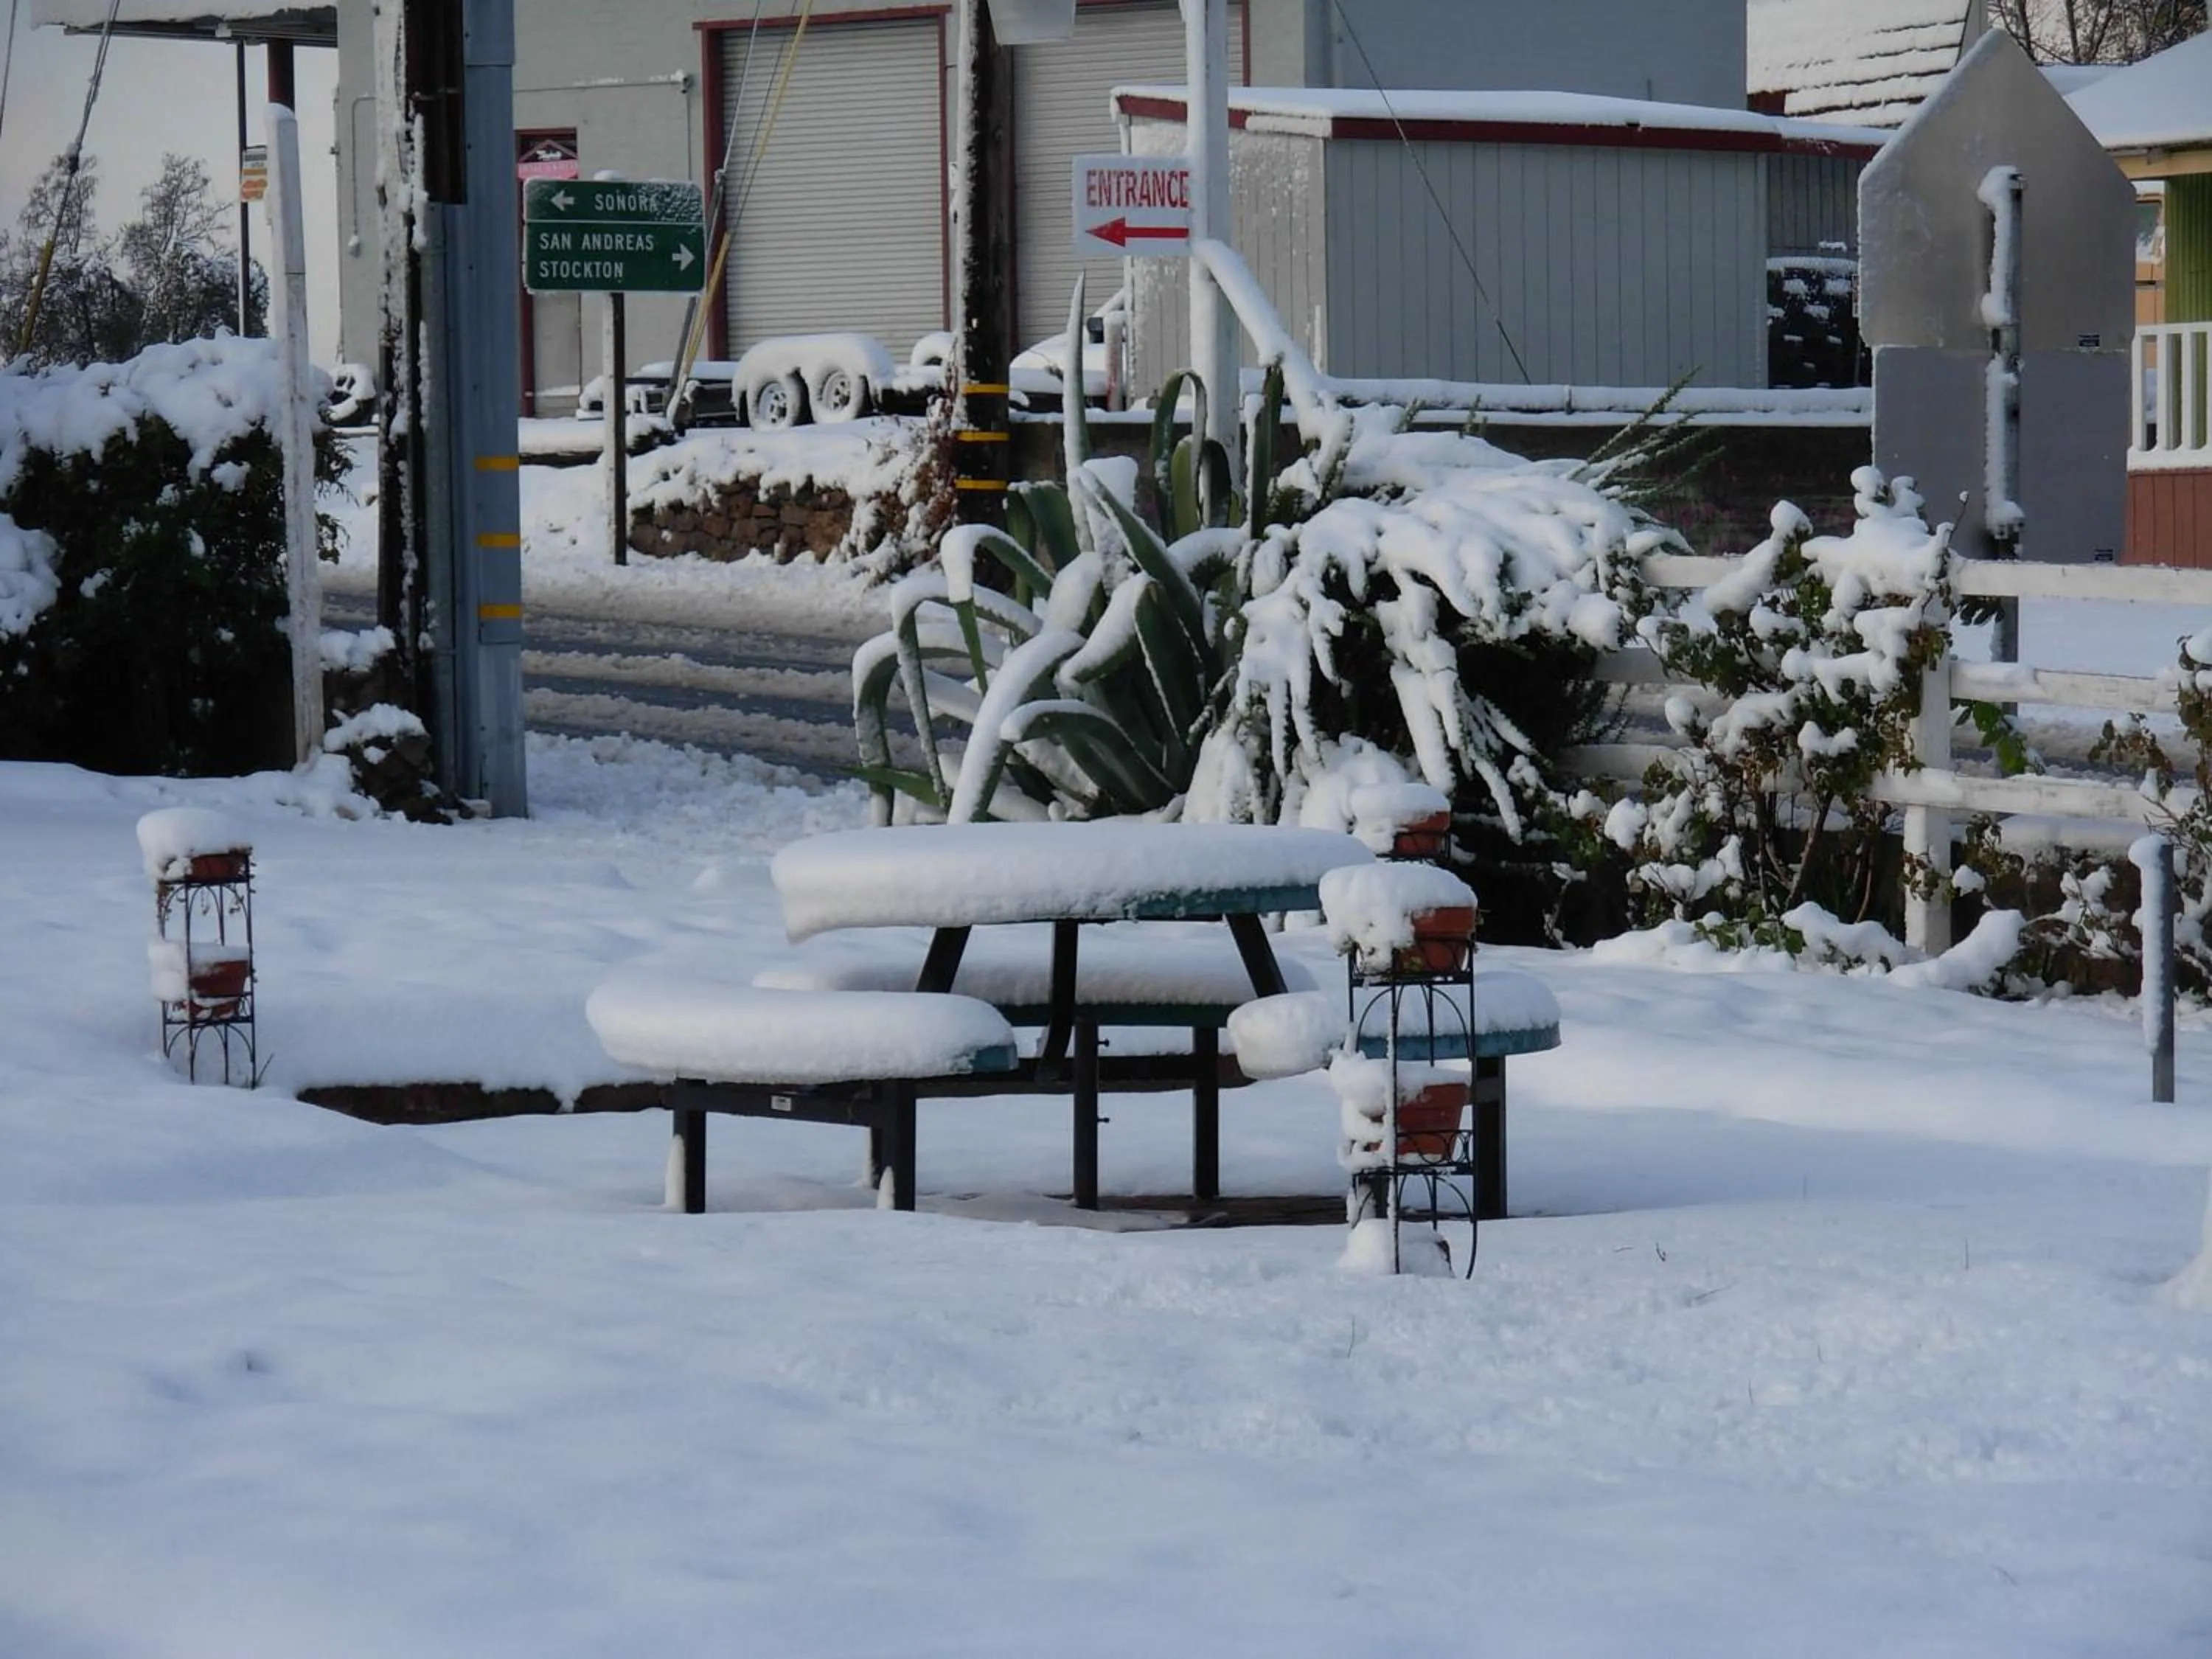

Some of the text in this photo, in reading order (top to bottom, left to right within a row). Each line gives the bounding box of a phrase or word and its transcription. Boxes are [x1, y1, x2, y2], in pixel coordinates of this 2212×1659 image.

[1086, 169, 1189, 208] ENTRANCE
[594, 193, 658, 212] SONORA
[539, 232, 655, 251] SAN ANDREAS
[539, 260, 624, 279] STOCKTON
